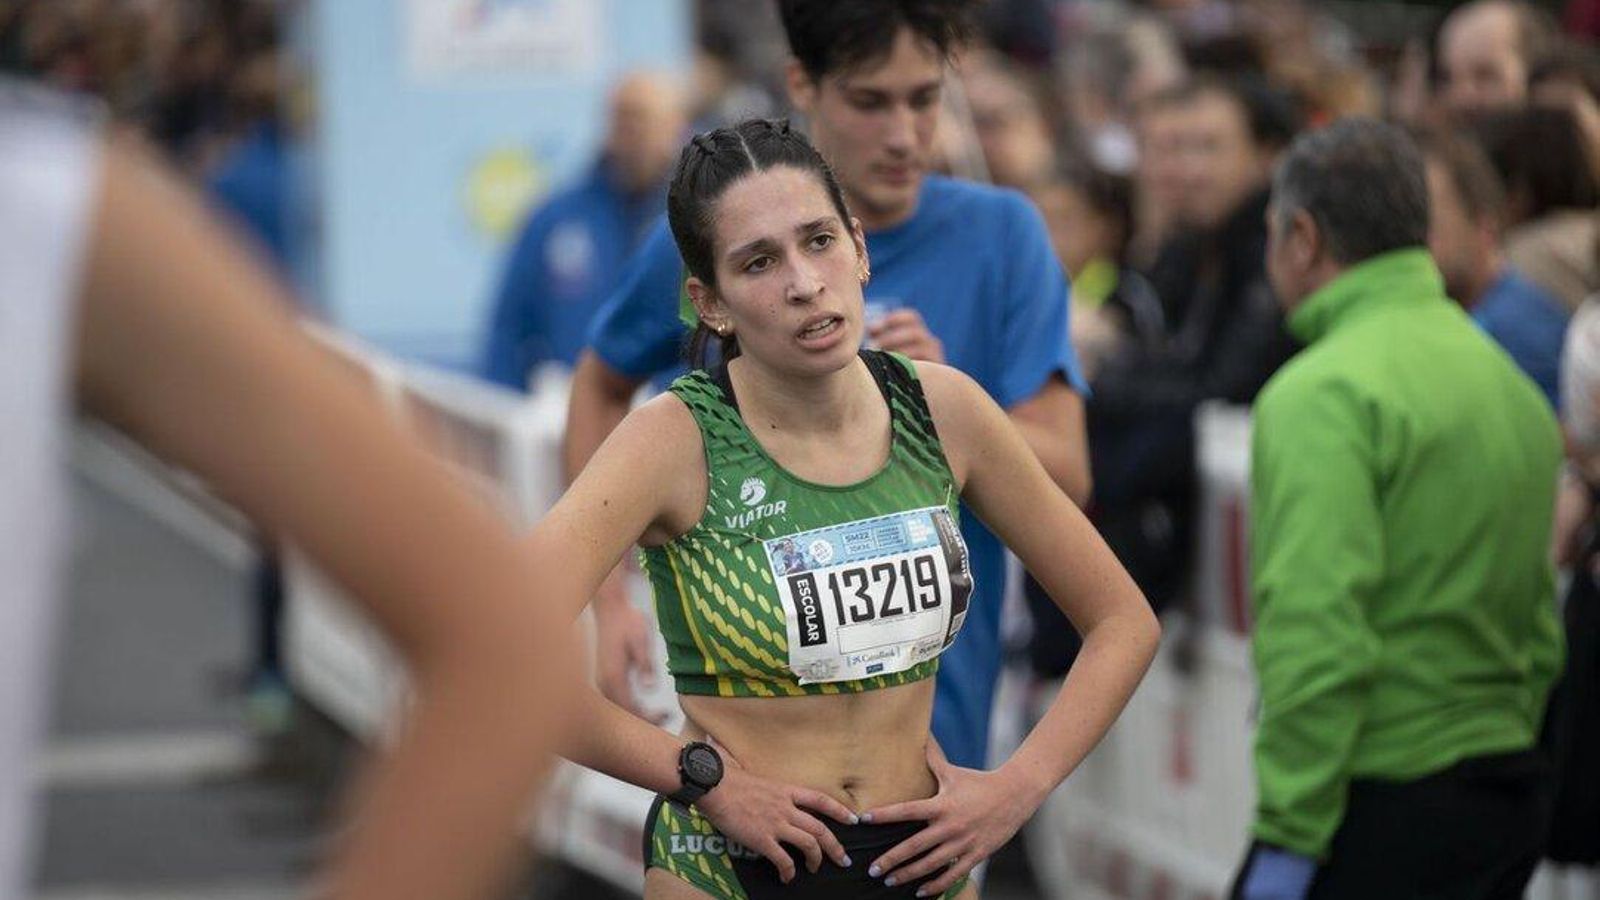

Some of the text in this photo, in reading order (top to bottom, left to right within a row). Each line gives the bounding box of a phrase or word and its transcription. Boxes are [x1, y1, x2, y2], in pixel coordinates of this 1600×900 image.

[725, 500, 787, 529] VIATOR
[797, 578, 820, 642] ESCOLAR
[828, 554, 941, 625] 13219
